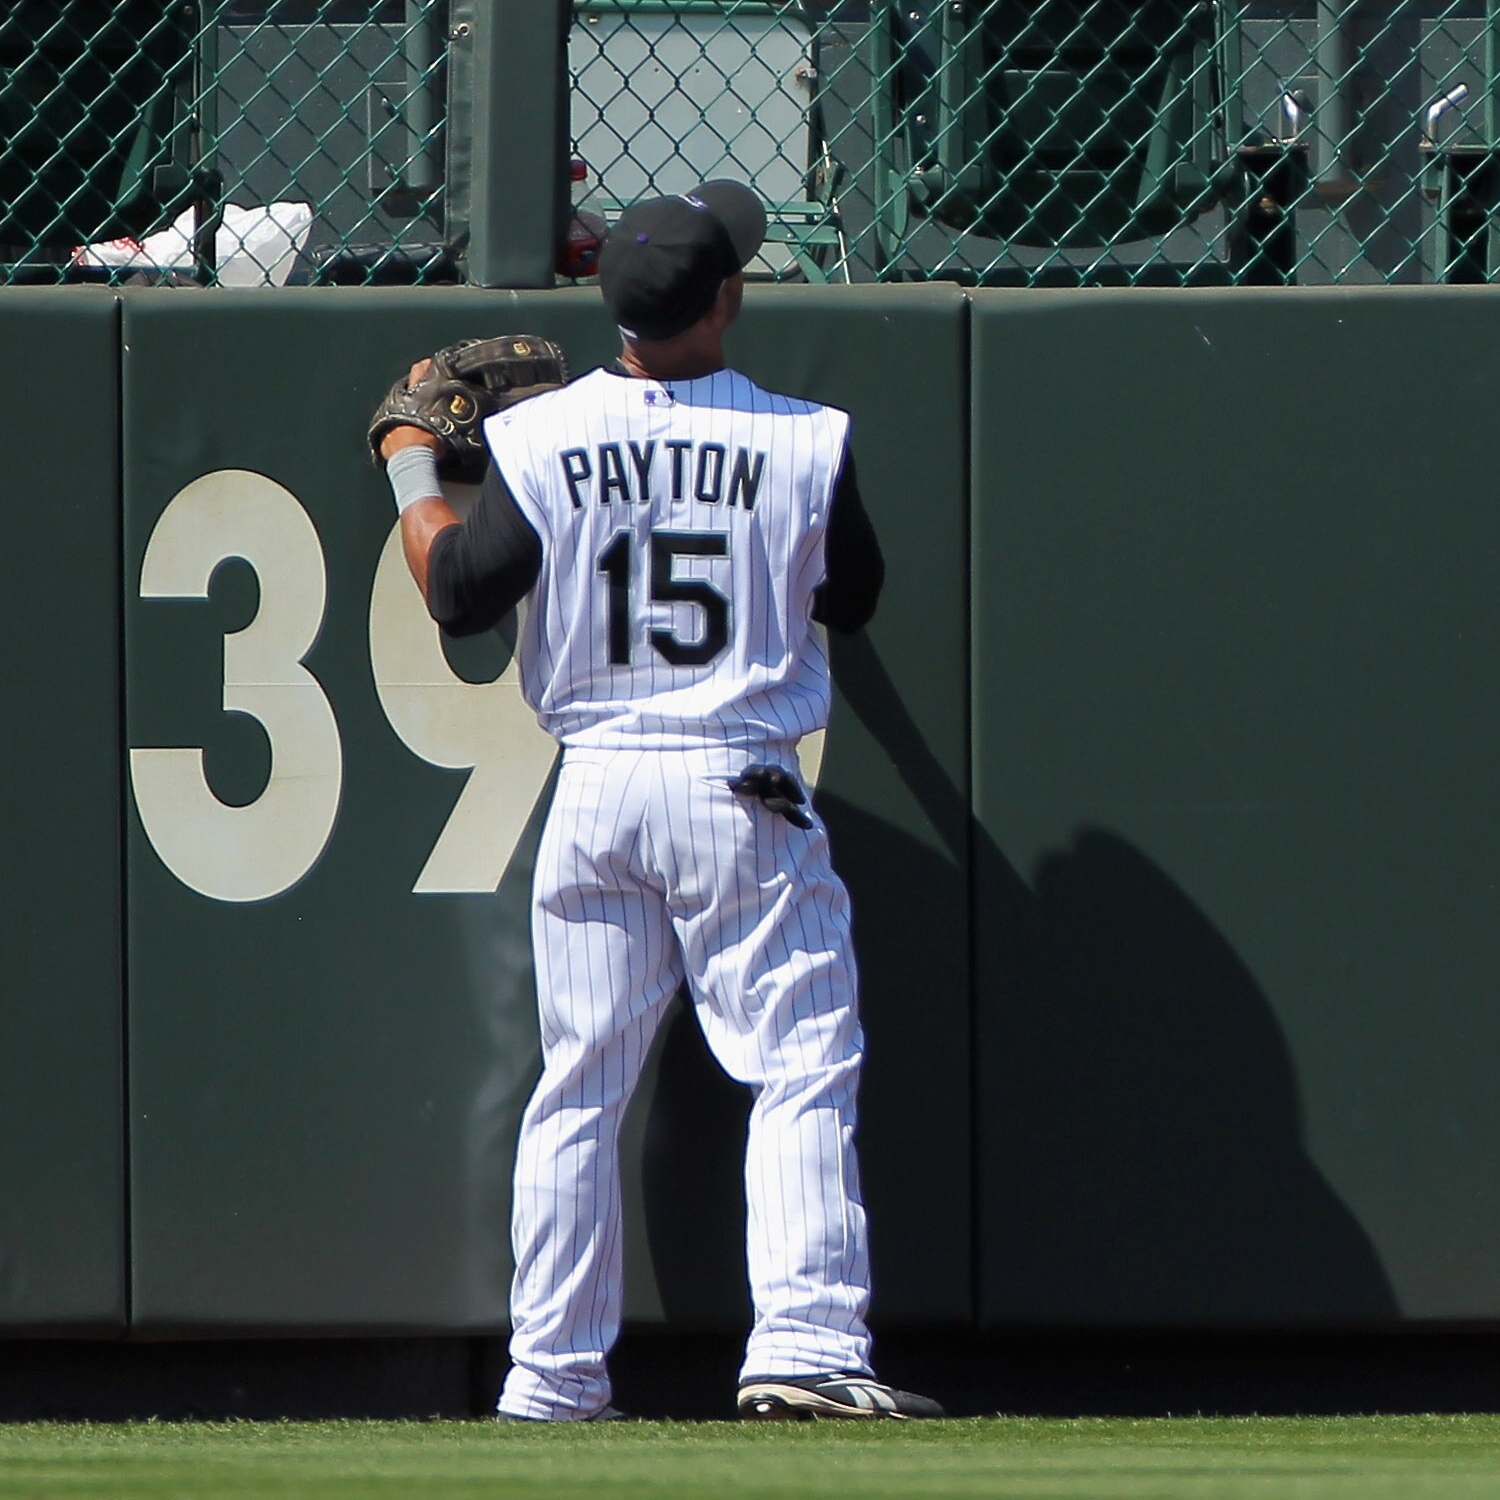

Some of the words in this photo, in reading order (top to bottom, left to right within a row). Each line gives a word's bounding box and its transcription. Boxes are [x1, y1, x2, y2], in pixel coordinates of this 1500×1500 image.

[560, 439, 767, 512] PAYTON
[596, 526, 732, 668] 15
[129, 469, 828, 903] 39
